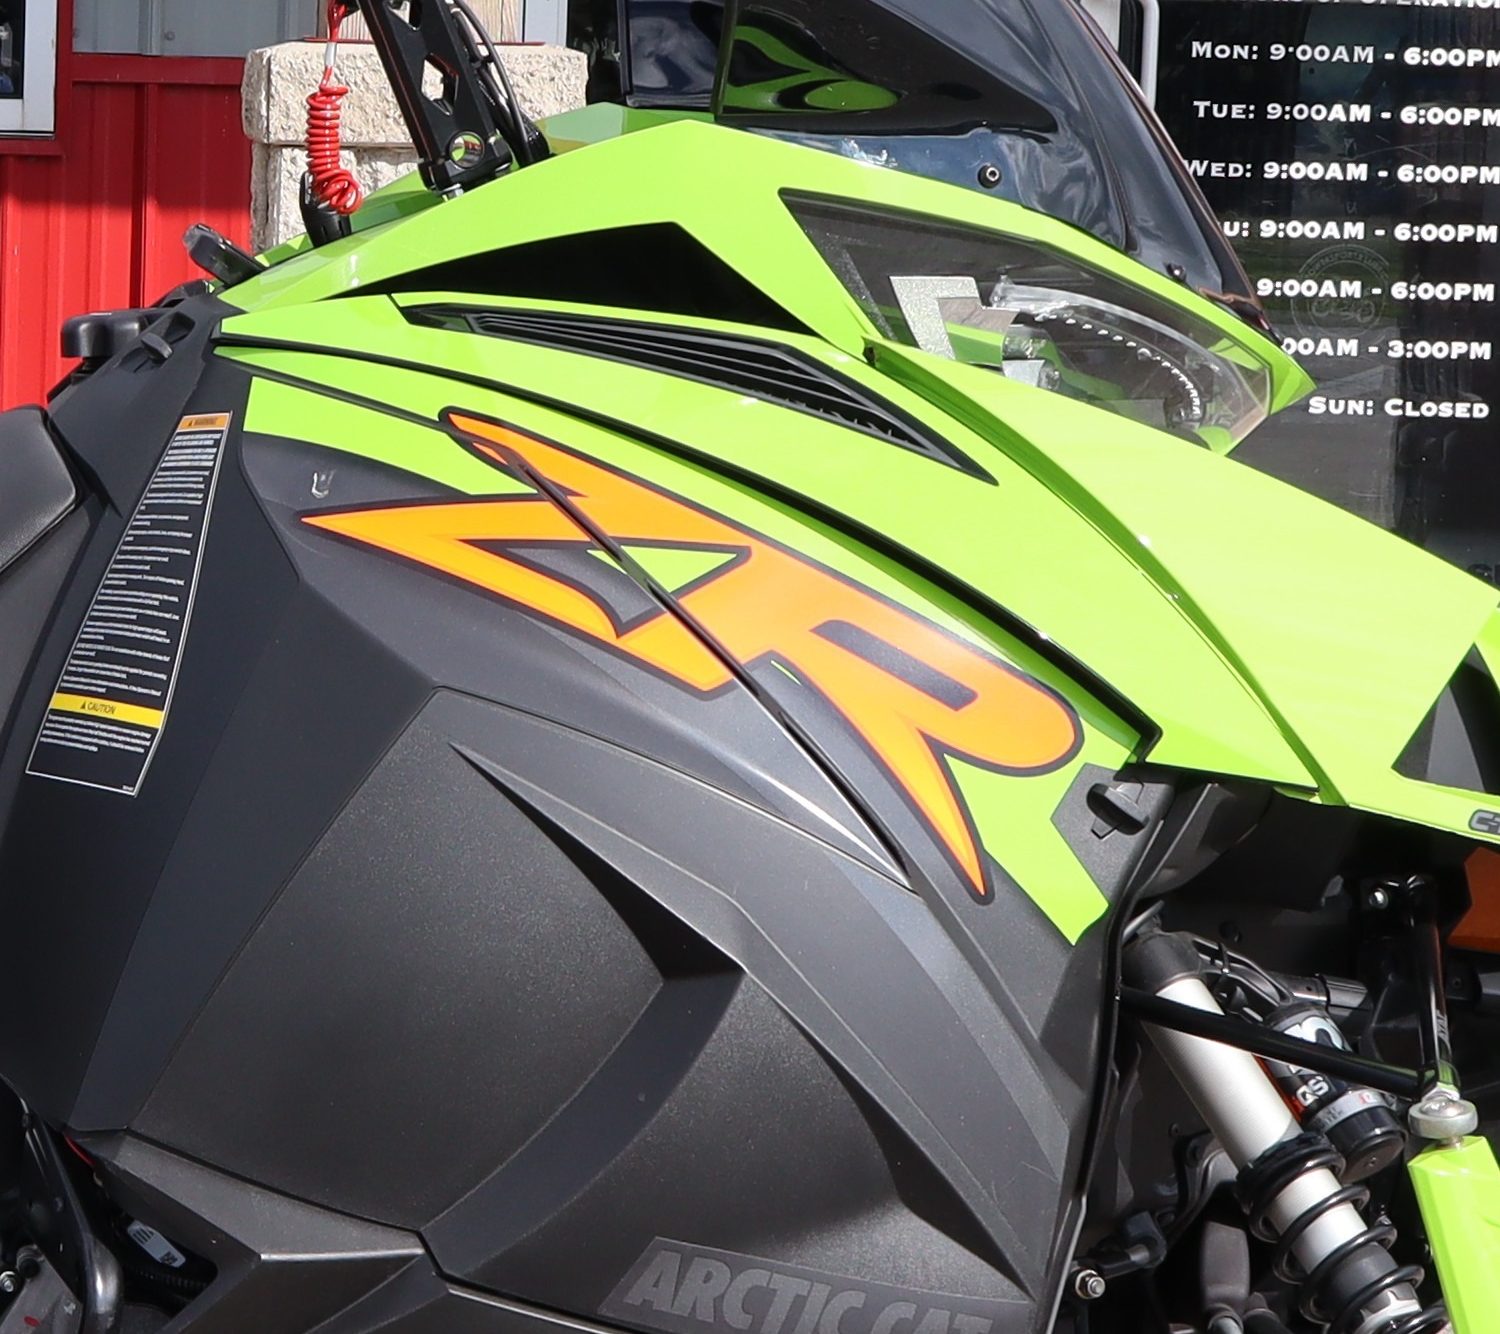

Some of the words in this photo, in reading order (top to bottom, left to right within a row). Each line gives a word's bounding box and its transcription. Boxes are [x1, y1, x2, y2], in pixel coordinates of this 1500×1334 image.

[1191, 41, 1260, 61] MON:
[1269, 43, 1375, 64] 9:00AM
[1193, 100, 1256, 120] TUE:
[1266, 102, 1372, 123] 9:00AM
[1186, 159, 1253, 180] WED:
[1262, 161, 1368, 182] 9:00AM
[1259, 220, 1366, 241] 9:00AM
[1393, 223, 1499, 244] 6:00PM
[1256, 278, 1363, 300] 9:00AM
[1390, 281, 1496, 303] 6:00PM
[1281, 336, 1359, 359] 00AM
[1387, 340, 1493, 362] 3:00PM
[1308, 396, 1375, 417] SUN:
[1384, 398, 1491, 421] CLOSED
[292, 407, 1084, 905] ZR
